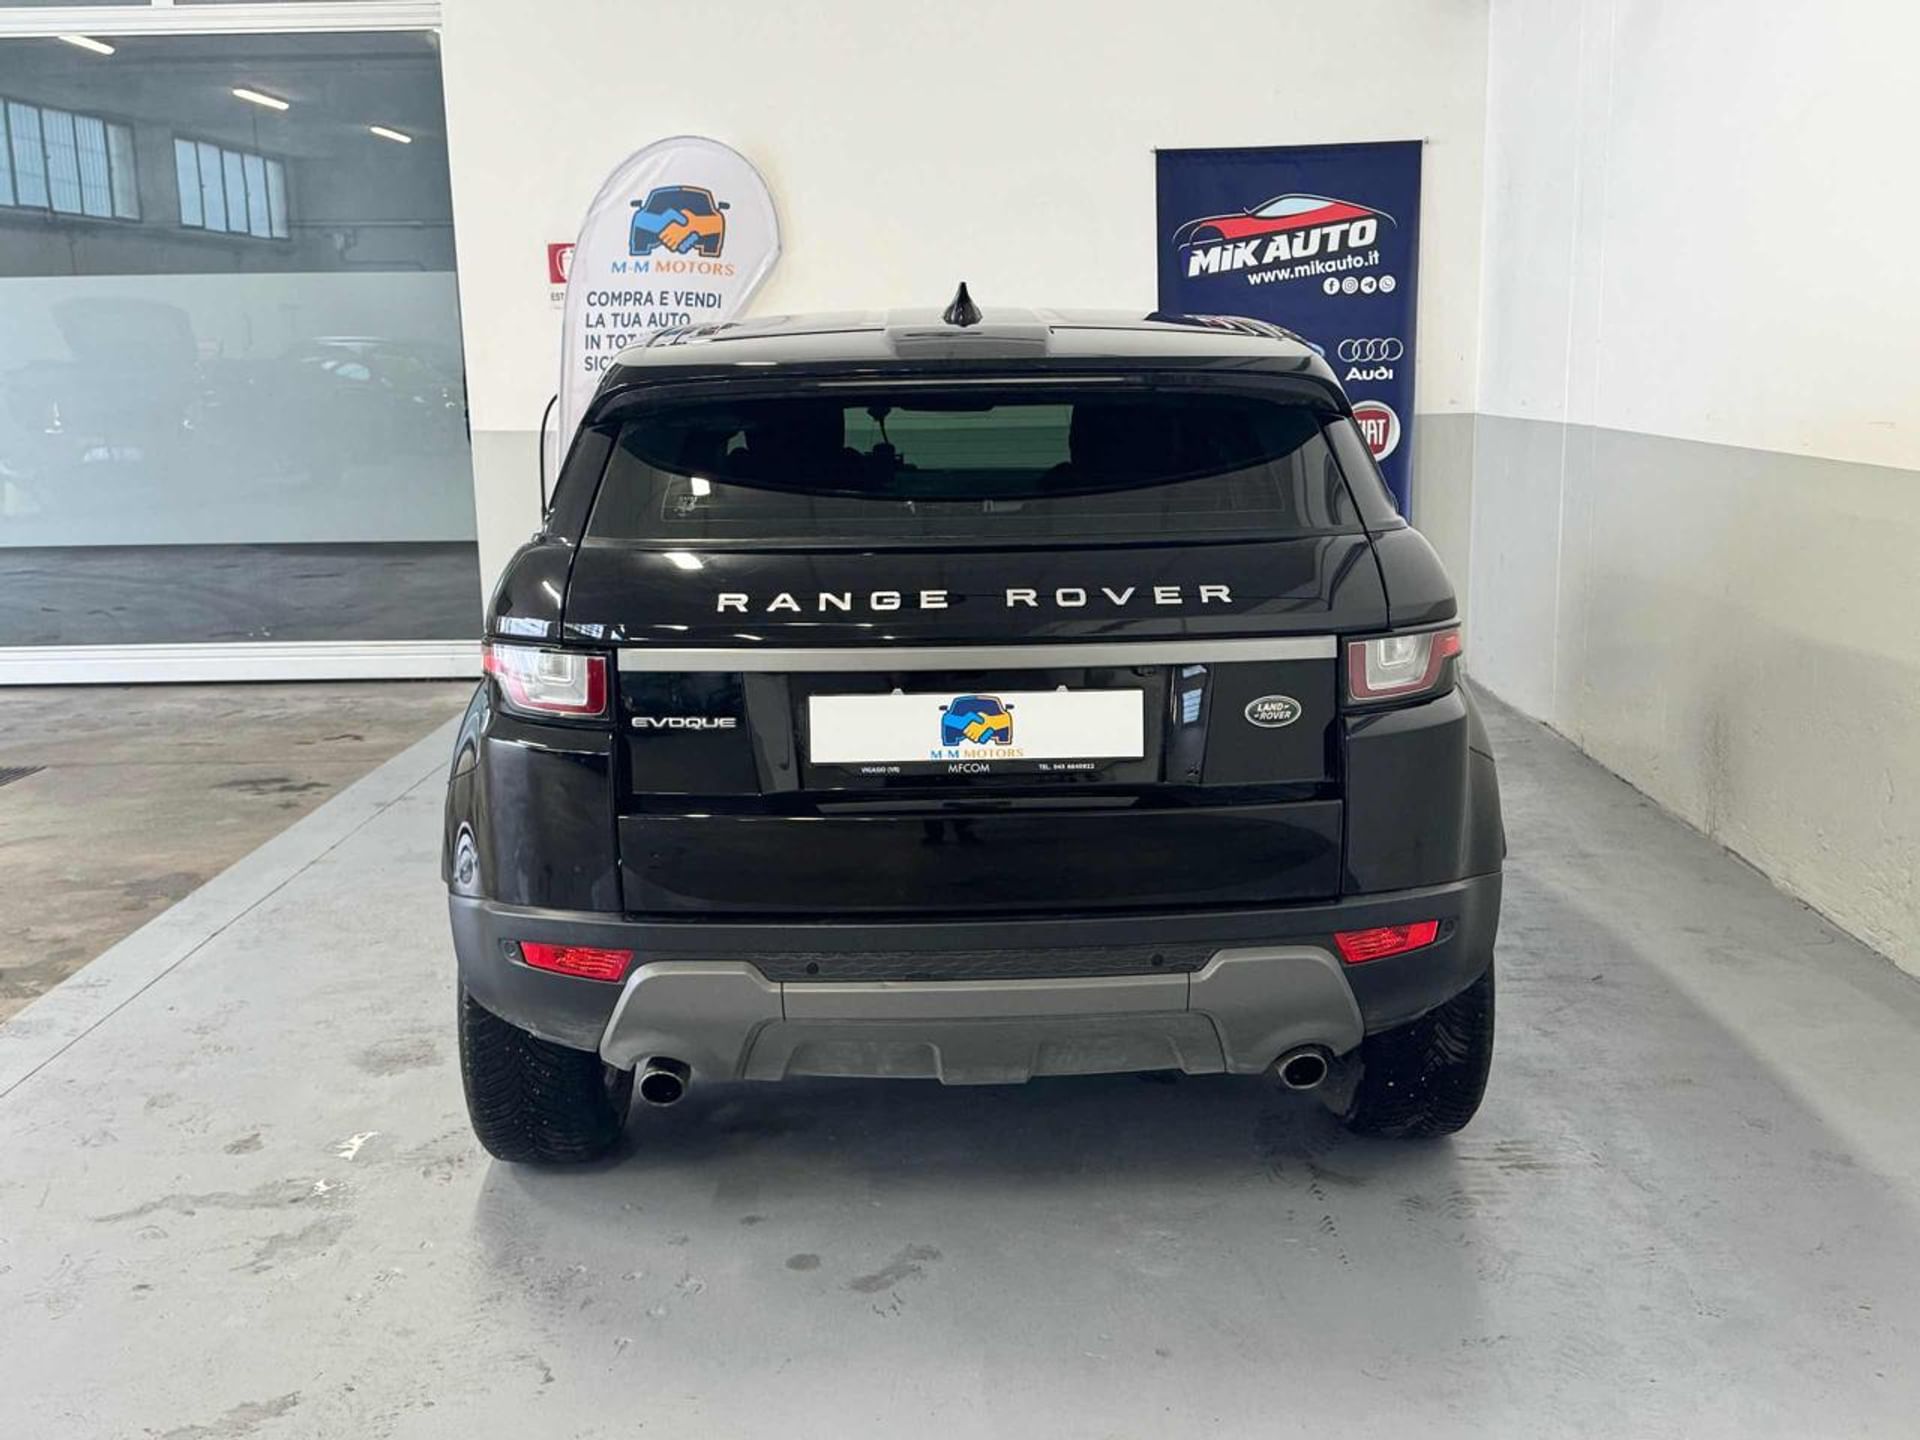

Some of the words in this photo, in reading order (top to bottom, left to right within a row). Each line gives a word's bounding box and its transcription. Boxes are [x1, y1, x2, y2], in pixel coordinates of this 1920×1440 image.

[655, 260, 735, 276] MOTORS
[1247, 249, 1380, 285] www.mikauto.it
[587, 291, 656, 306] COMPRA
[659, 291, 670, 306] E
[674, 291, 722, 308] VENDI
[586, 313, 605, 328] LA
[611, 313, 642, 328] TUA
[647, 313, 691, 328] AUTO
[585, 334, 601, 349] IN
[1345, 366, 1394, 381] Audi
[1357, 419, 1387, 446] IAT
[717, 590, 948, 612] RANGE
[1006, 585, 1232, 607] ROVER
[632, 717, 737, 730] EVOQUE
[964, 748, 1024, 758] MOTORS
[948, 763, 990, 774] MFCOM
